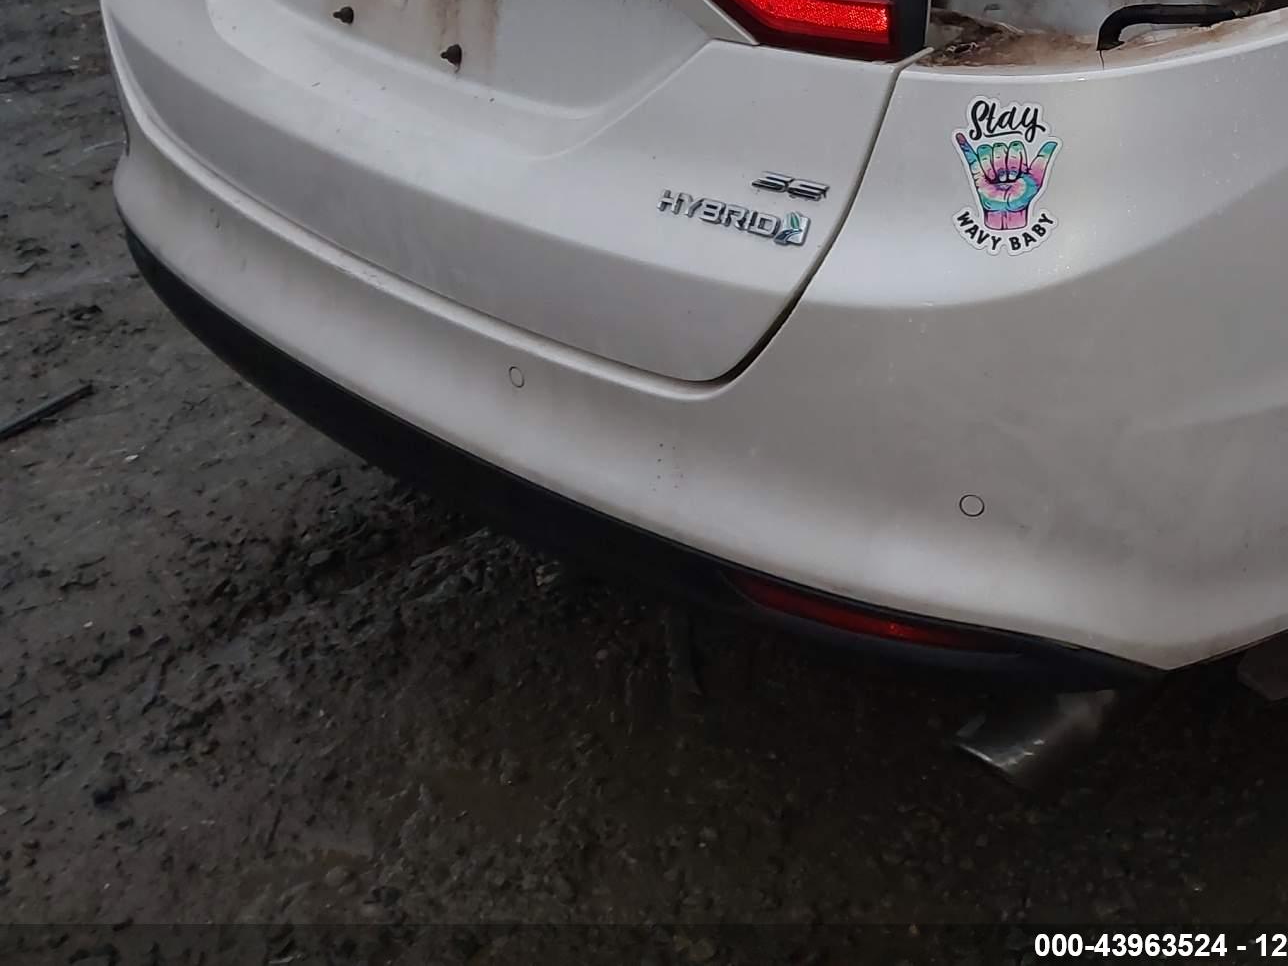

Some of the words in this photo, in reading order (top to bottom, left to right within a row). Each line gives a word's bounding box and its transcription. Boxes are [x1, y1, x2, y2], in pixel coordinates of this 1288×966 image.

[969, 100, 1046, 143] Stay
[657, 190, 781, 238] HYBRID
[956, 211, 1001, 251] WAVY
[1009, 213, 1053, 251] BABY
